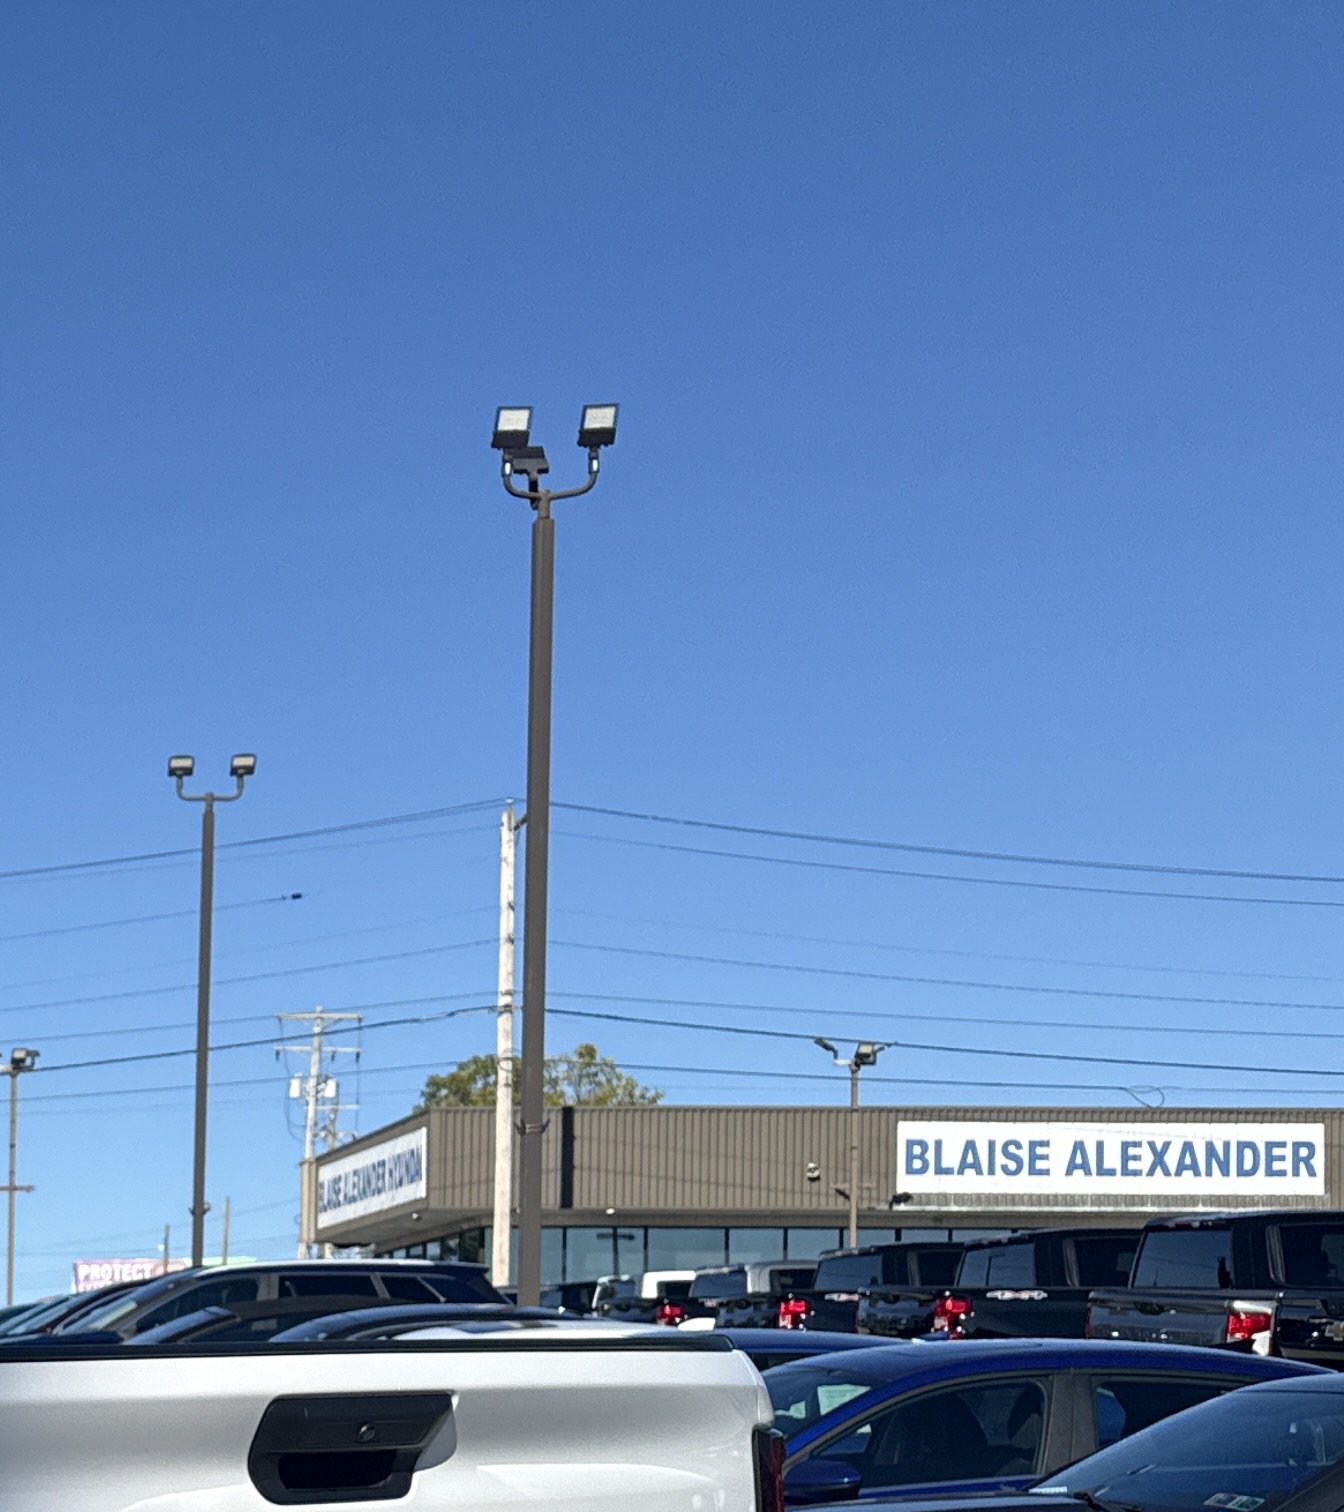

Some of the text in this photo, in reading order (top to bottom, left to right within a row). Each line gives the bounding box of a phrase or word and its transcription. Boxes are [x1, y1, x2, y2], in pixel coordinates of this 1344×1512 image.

[904, 1138, 1318, 1178] BLAISE ALEXANDER
[77, 1263, 155, 1282] PROTECT
